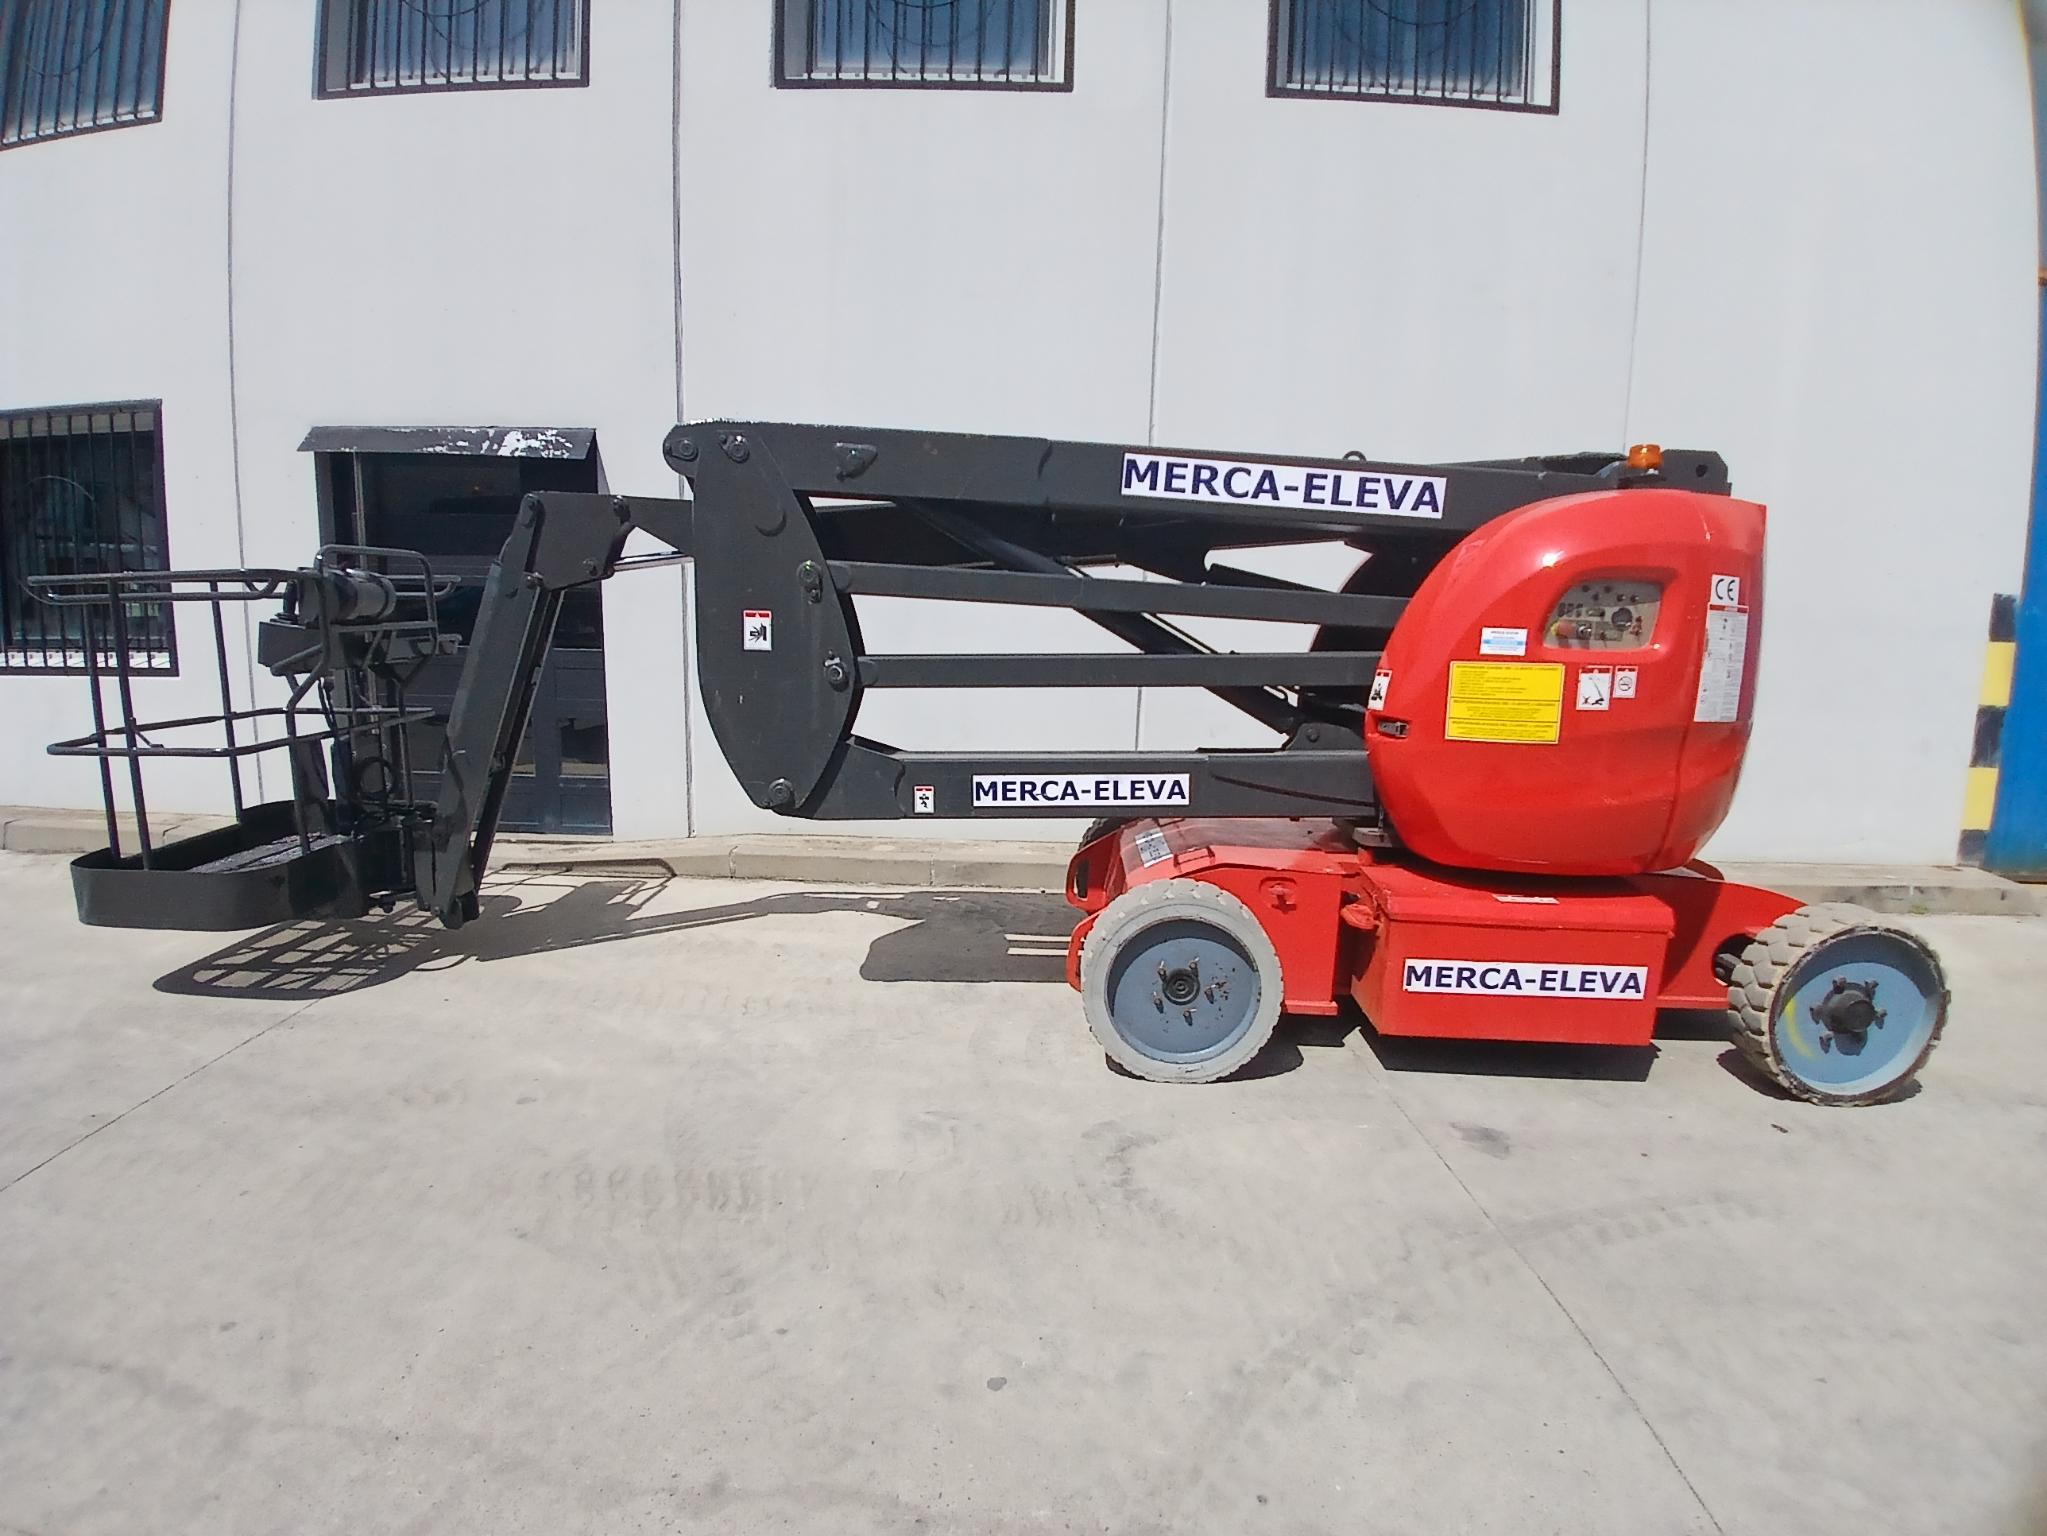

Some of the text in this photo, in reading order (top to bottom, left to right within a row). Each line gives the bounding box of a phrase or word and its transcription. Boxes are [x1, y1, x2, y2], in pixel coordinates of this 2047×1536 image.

[1123, 458, 1440, 513] MERCA-ELEVA
[1715, 578, 1736, 601] CE
[975, 779, 1187, 802] MERCA-ELEVA
[1405, 965, 1641, 994] MERCA-ELEVA
